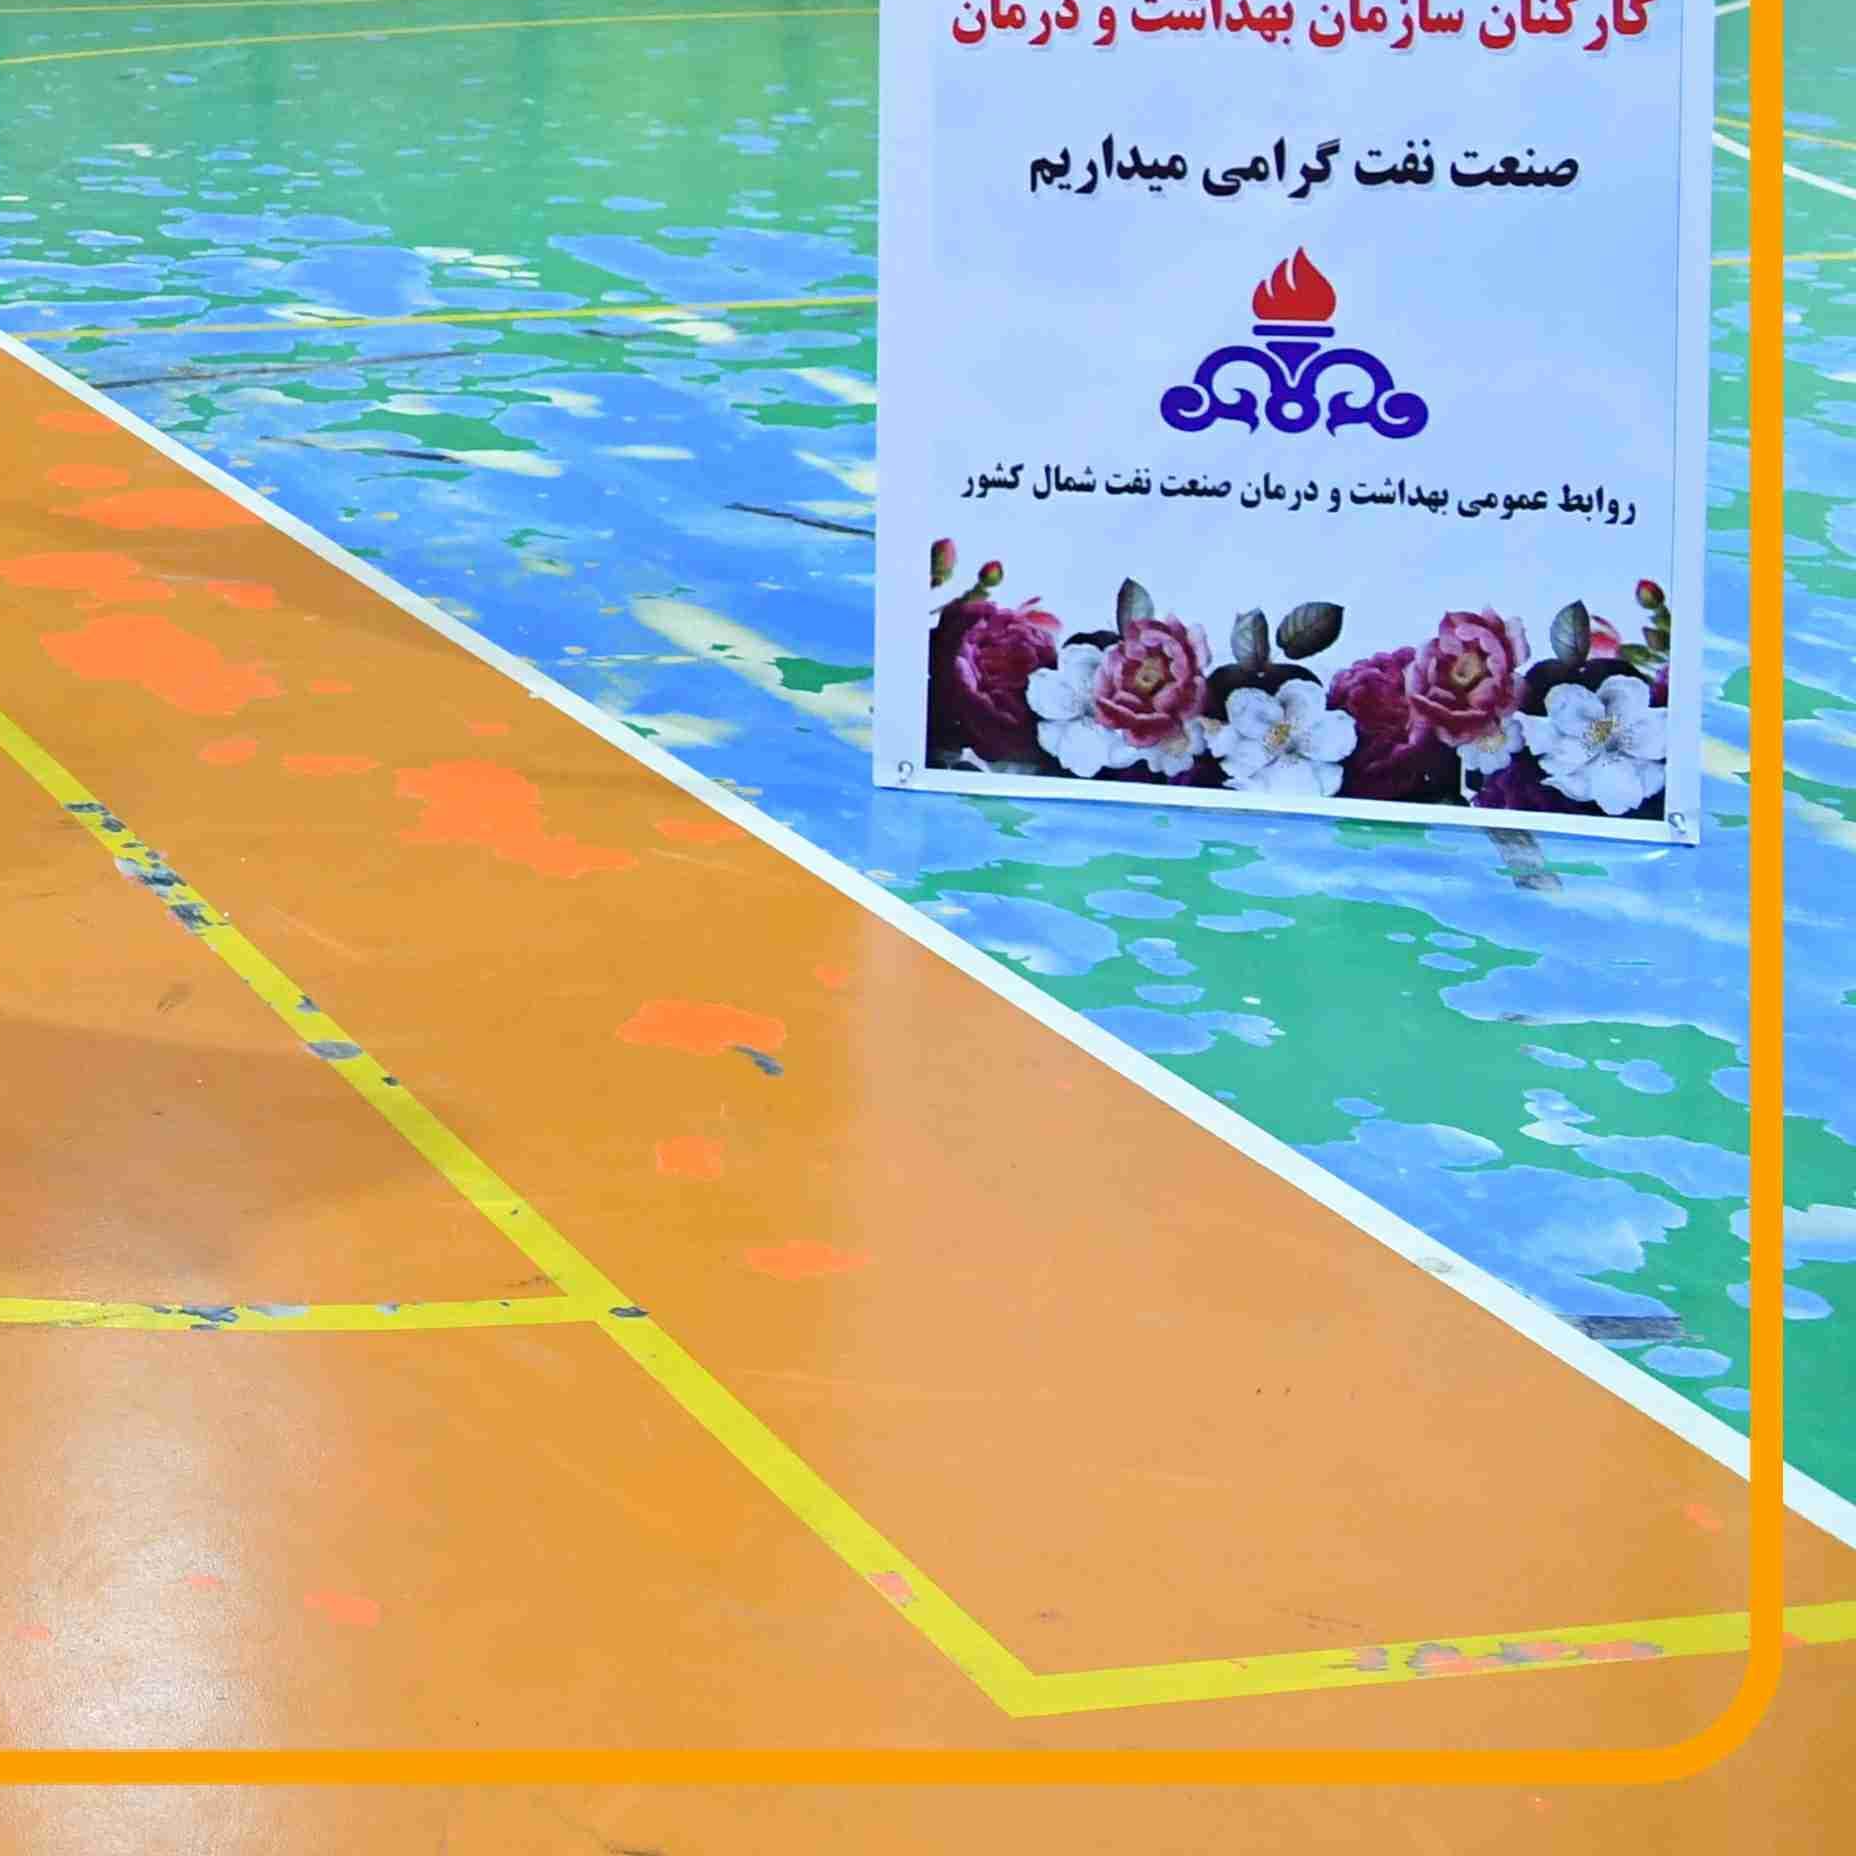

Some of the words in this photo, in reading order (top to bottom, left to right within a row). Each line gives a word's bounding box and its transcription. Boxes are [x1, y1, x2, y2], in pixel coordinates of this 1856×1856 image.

[1095, 6, 1117, 48] و
[1202, 137, 1341, 199] گرامی
[1354, 138, 1435, 186] نفت
[1450, 148, 1579, 188] صنعت
[961, 463, 1024, 499] کشور
[1032, 463, 1097, 500] شمال
[1104, 467, 1153, 498] نفت
[1158, 470, 1233, 500] صنعت
[1240, 472, 1319, 511] درمان
[1349, 478, 1449, 514] بهداشت
[1327, 487, 1341, 513] و
[1457, 490, 1548, 520] عمومی
[1557, 484, 1636, 526] روابط
